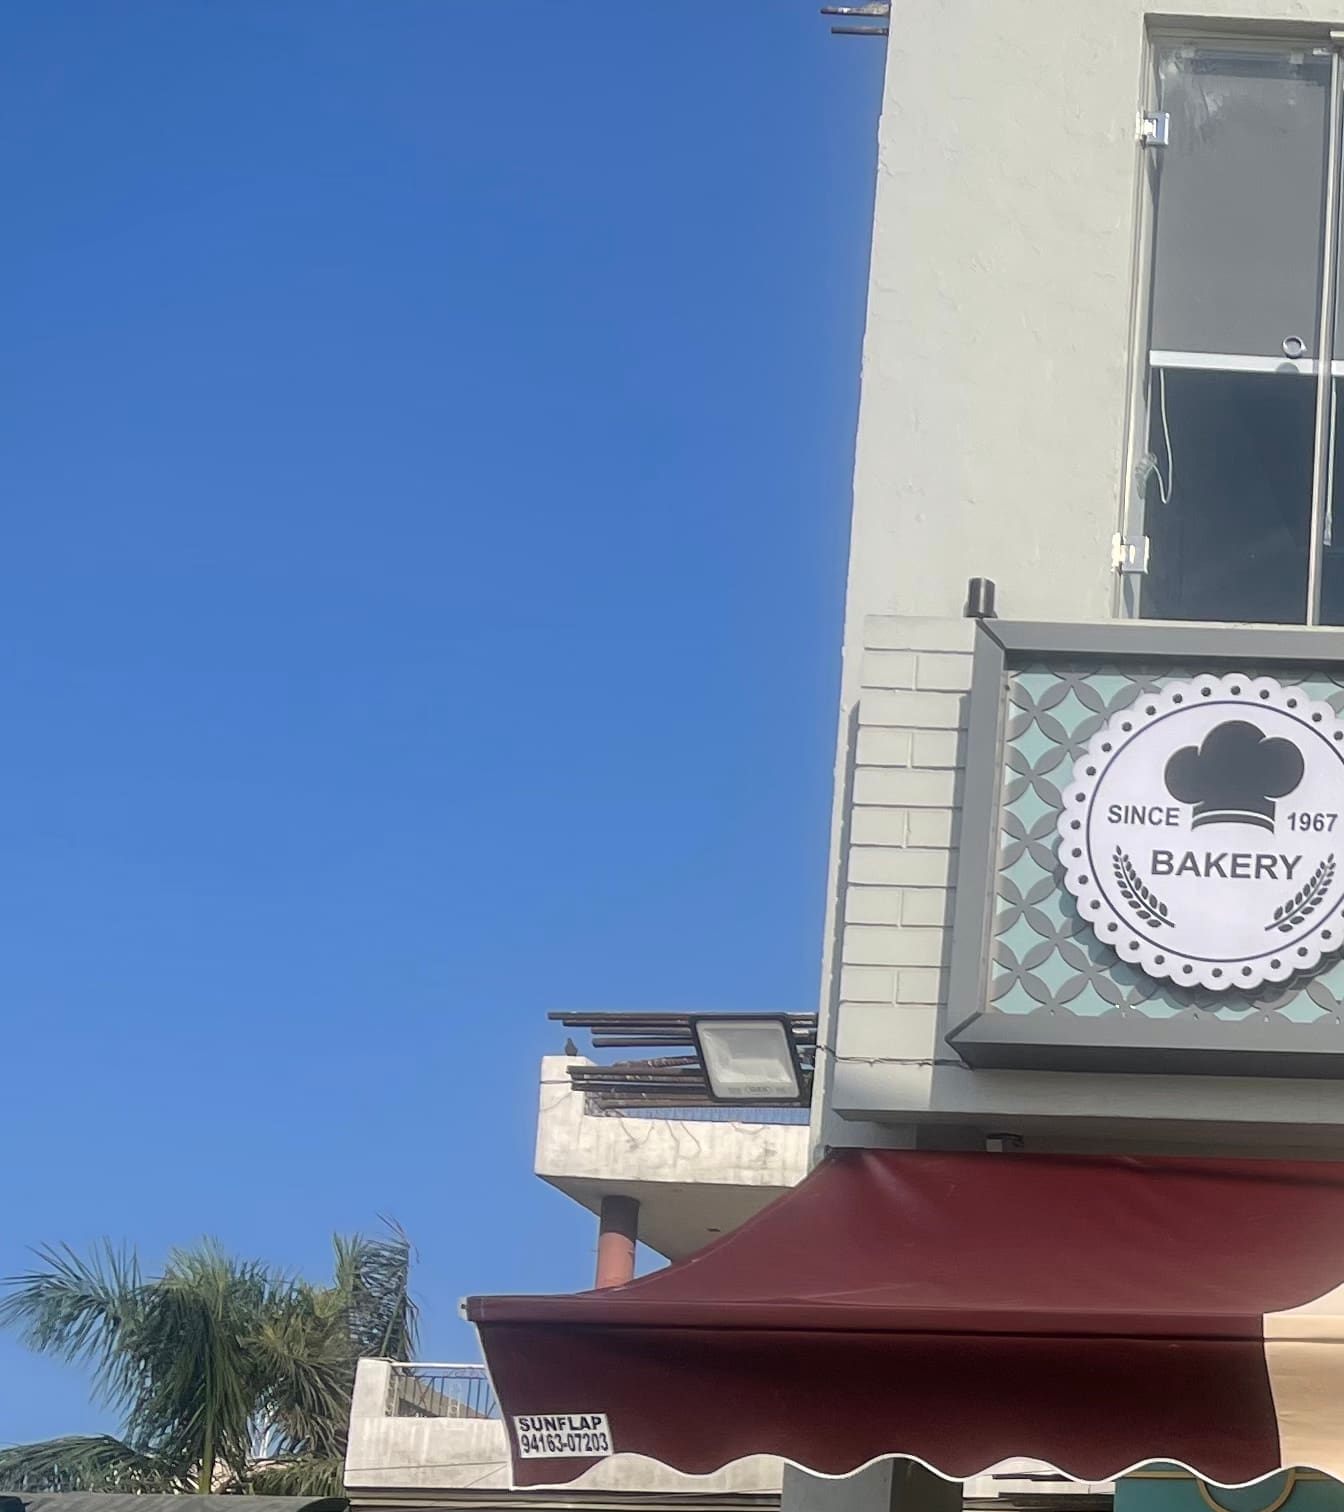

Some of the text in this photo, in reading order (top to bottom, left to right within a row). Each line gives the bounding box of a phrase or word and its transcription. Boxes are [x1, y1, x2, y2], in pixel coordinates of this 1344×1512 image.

[1107, 804, 1339, 832] SINCE 1967
[1150, 850, 1303, 880] BAKERY
[519, 1416, 602, 1432] SUNFLAP
[521, 1433, 608, 1453] 94163-07203
